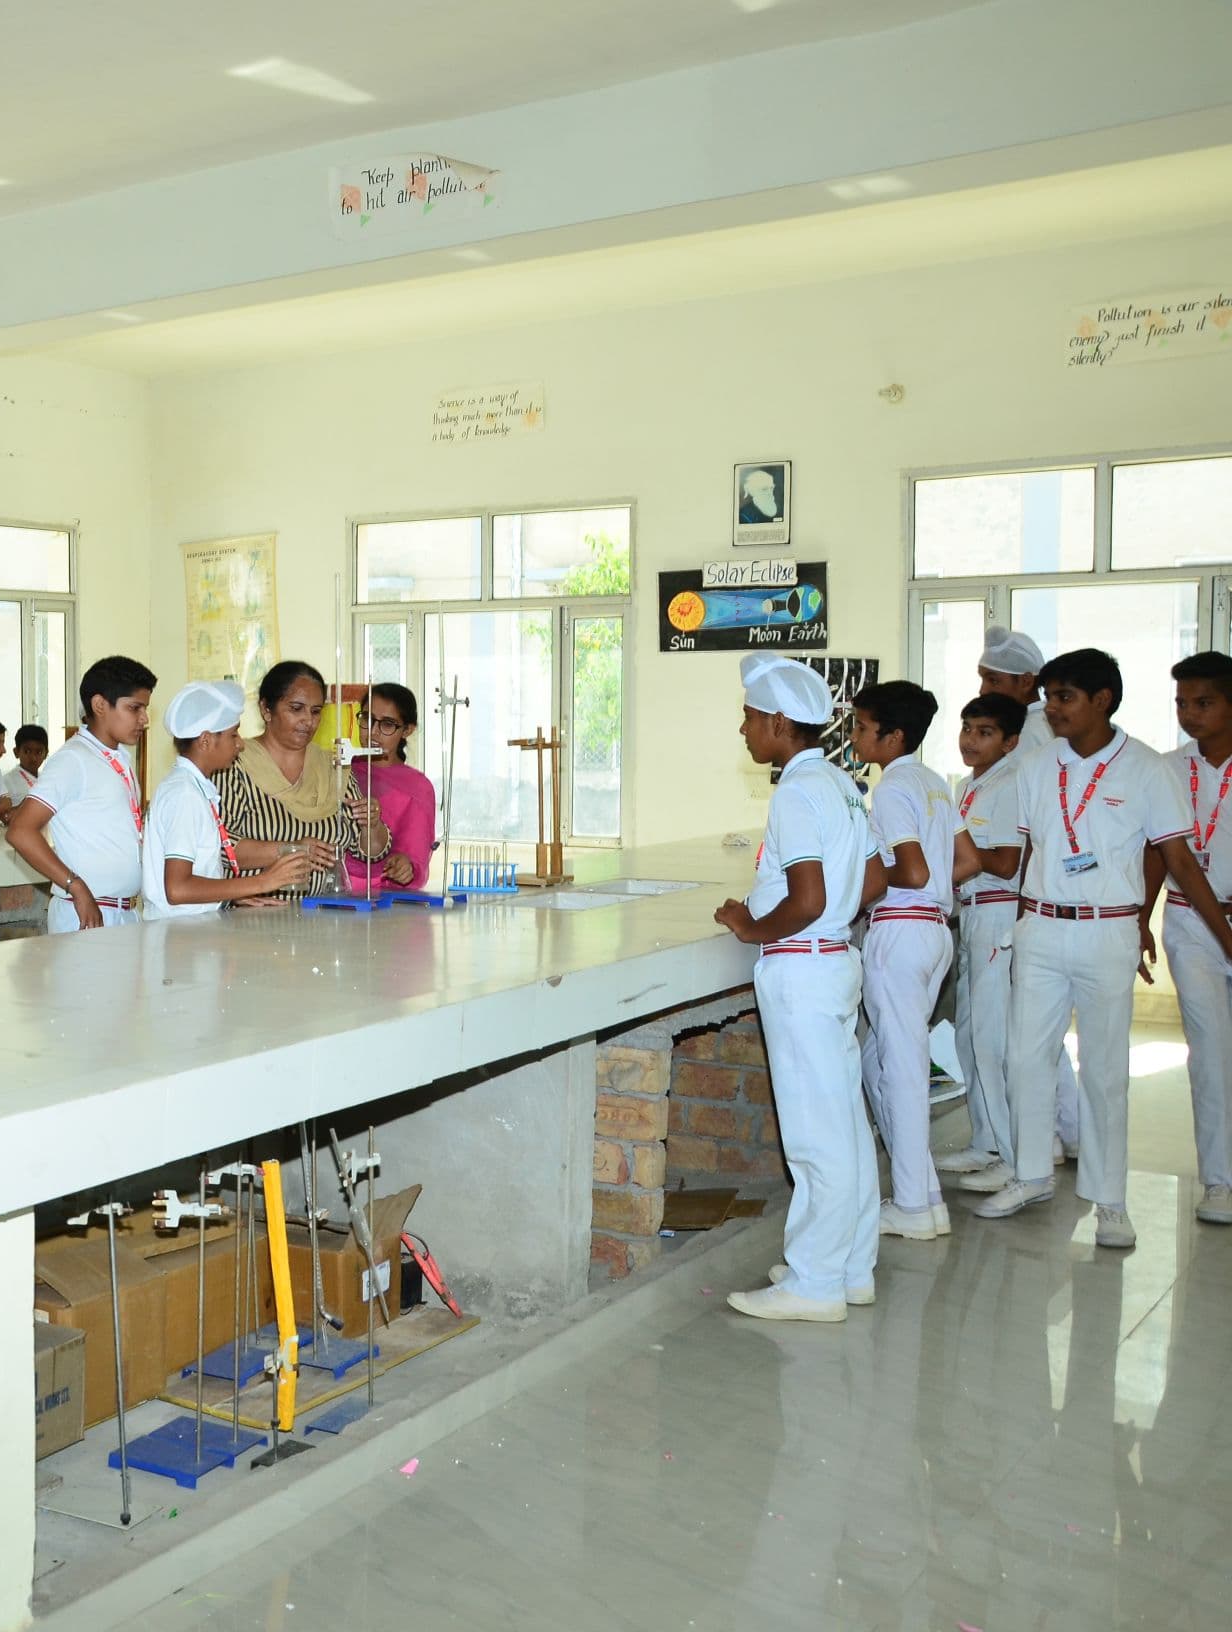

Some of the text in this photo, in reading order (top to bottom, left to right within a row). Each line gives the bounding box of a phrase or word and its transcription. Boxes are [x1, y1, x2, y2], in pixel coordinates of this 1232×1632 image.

[361, 167, 394, 188] Keep
[341, 198, 353, 215] to
[396, 189, 416, 204] air
[1097, 304, 1152, 323] Pollution
[1161, 305, 1171, 314] is
[1176, 301, 1200, 312] our
[1145, 319, 1185, 346] finish
[510, 389, 519, 404] of
[462, 410, 481, 422] much
[505, 405, 524, 417] than
[461, 426, 471, 440] of
[707, 563, 749, 585] Solar
[669, 635, 695, 650] Sun
[748, 623, 827, 643] Moon Earth
